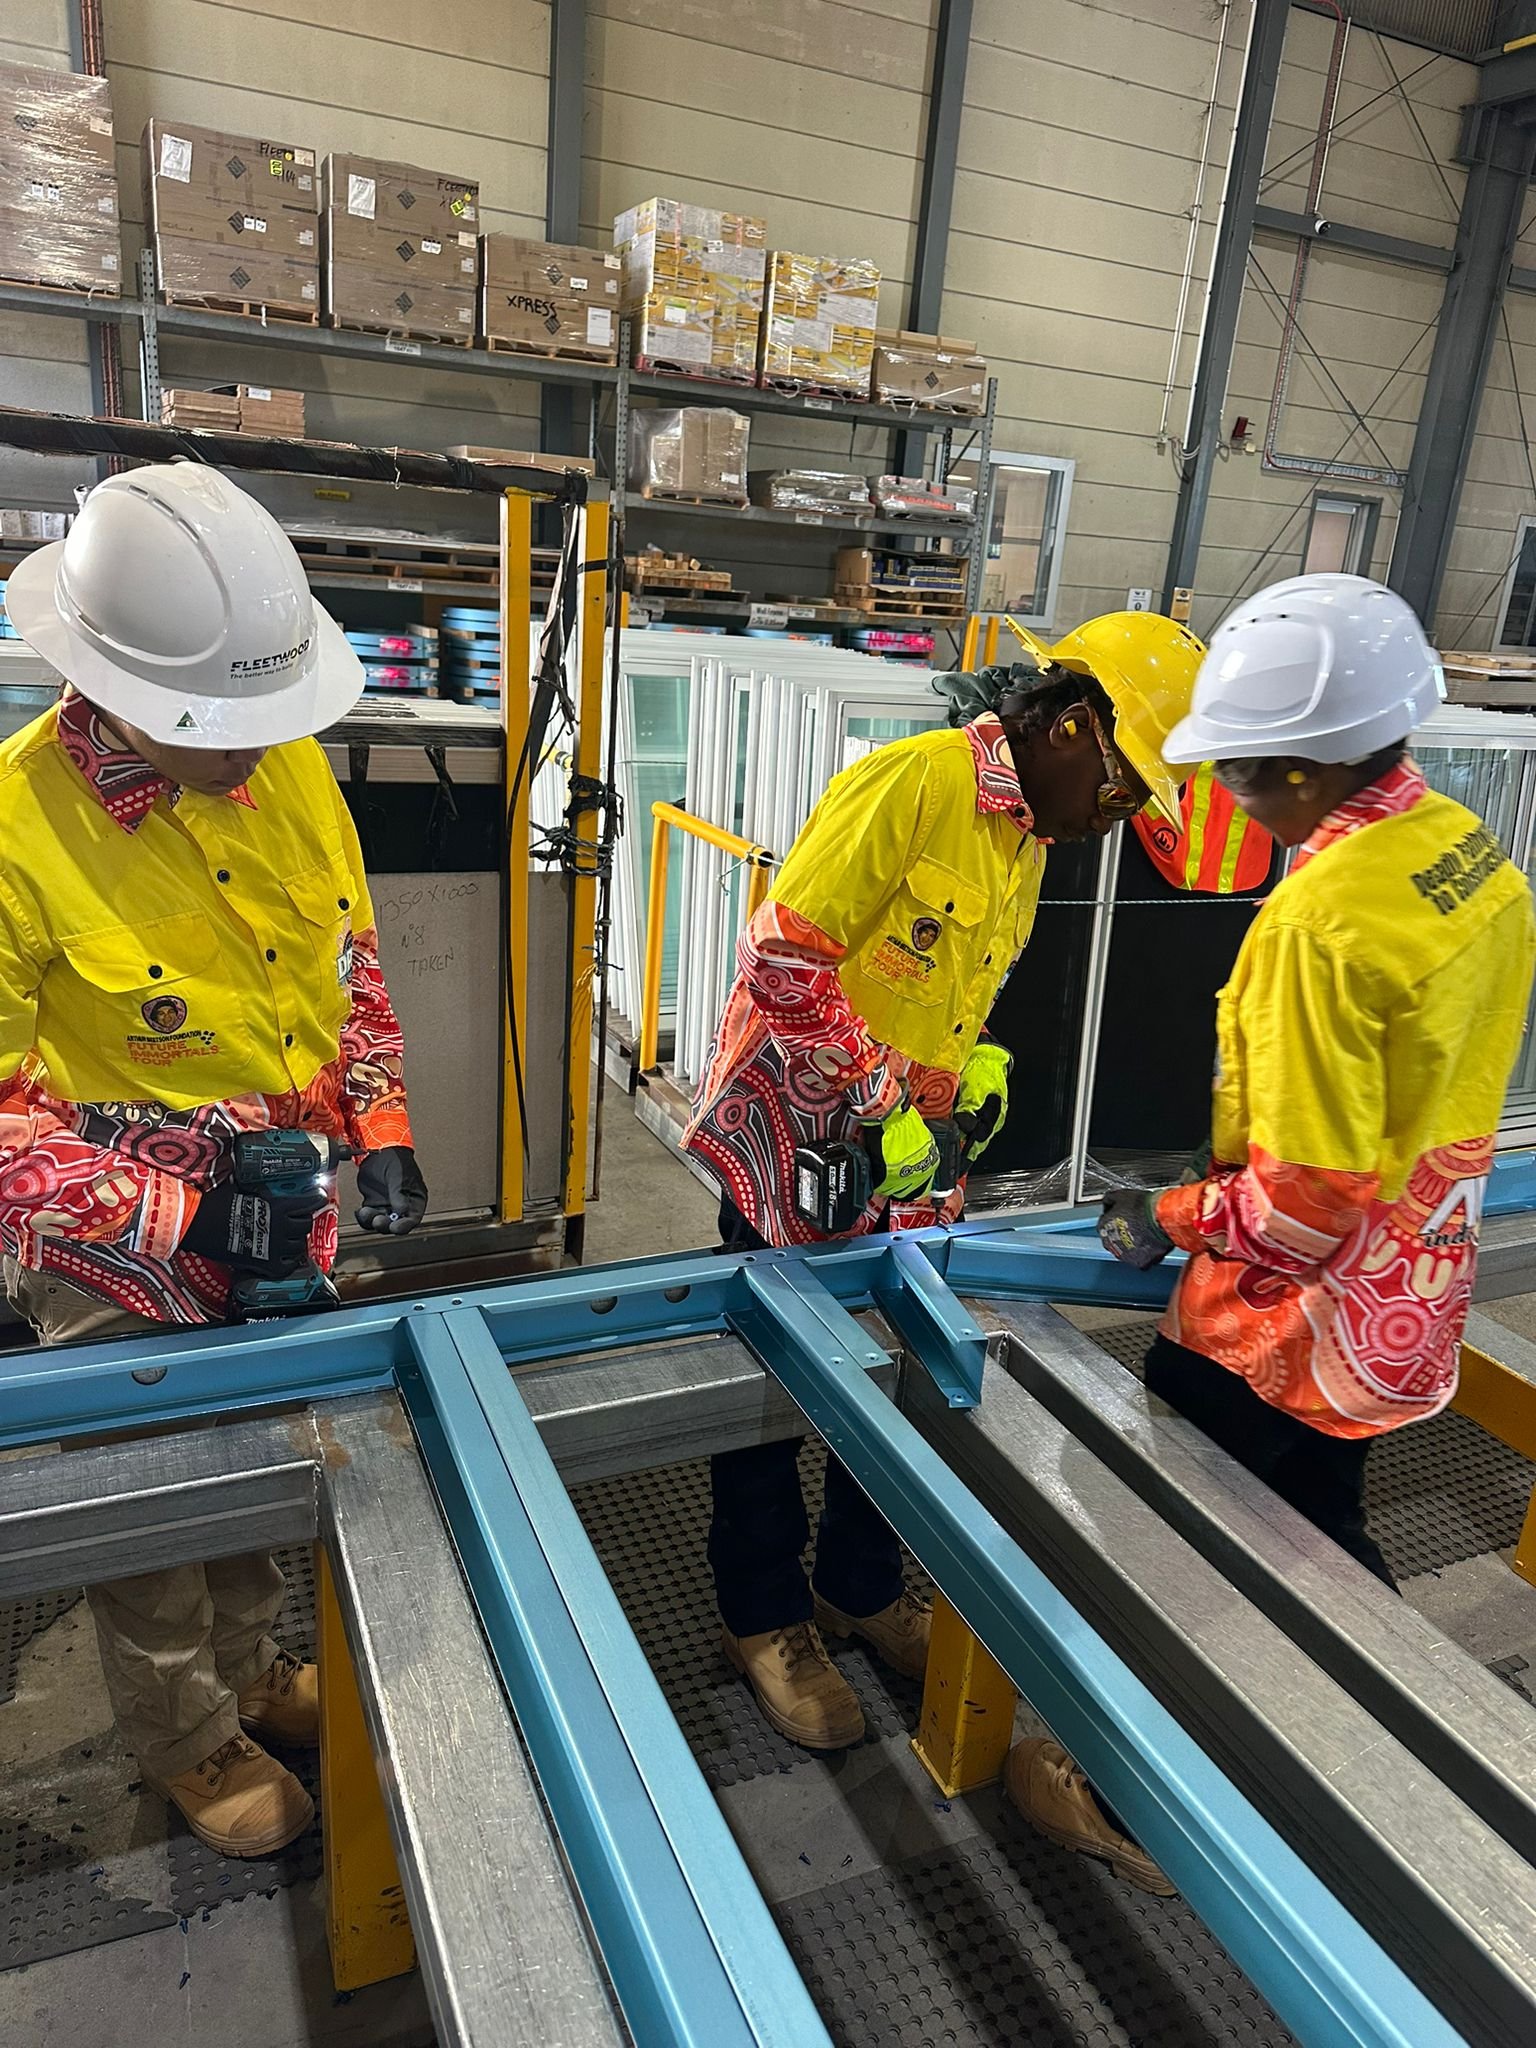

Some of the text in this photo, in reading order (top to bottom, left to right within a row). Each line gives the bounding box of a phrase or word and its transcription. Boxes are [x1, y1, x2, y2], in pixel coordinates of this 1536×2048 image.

[507, 295, 558, 319] XPRESS
[230, 639, 309, 672] FLEETWOOD
[244, 670, 263, 679] better
[408, 946, 454, 977] TAKEN
[881, 940, 919, 969] FUTURE
[873, 956, 901, 981] TOUR
[127, 1040, 187, 1052] FUTURE
[130, 1044, 219, 1060] IMMORTALS
[130, 1057, 172, 1068] TOUR
